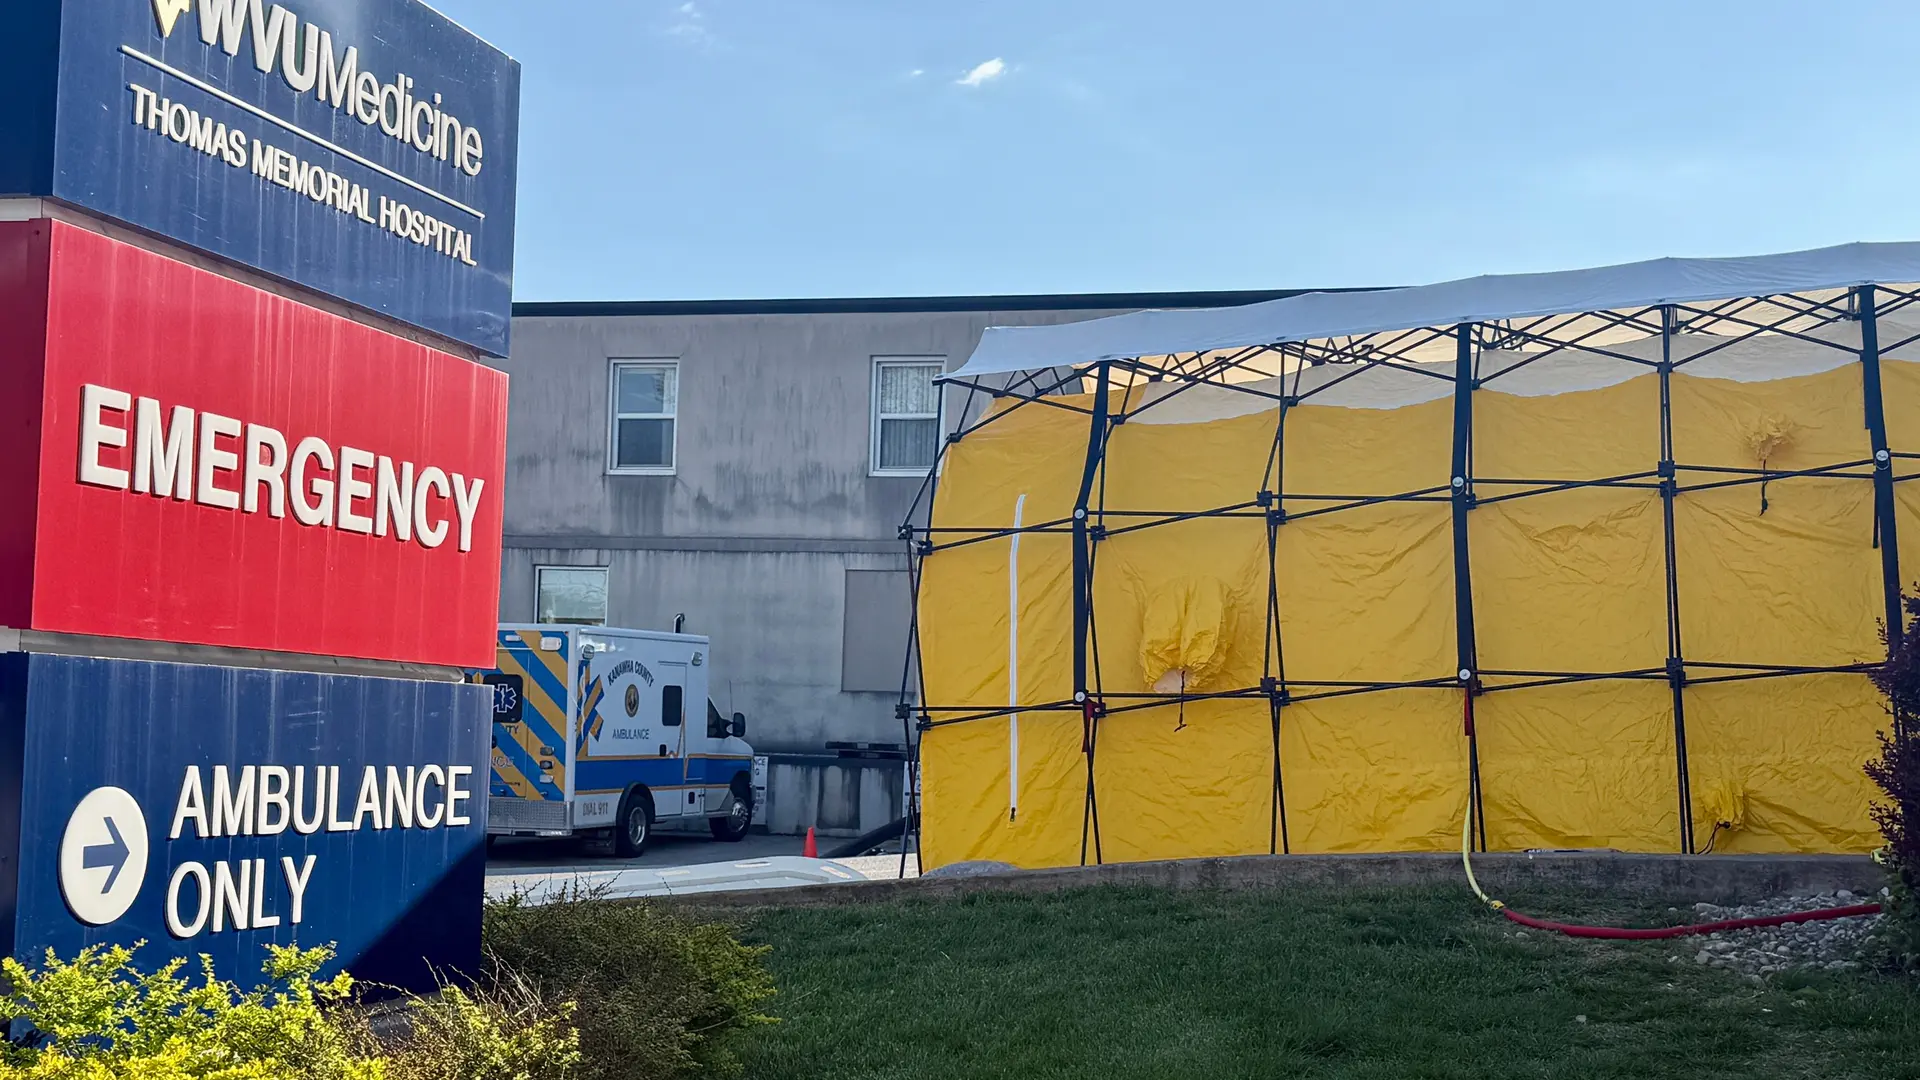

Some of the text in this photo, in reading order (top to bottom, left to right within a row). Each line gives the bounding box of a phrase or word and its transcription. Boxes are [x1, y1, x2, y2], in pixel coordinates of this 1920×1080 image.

[129, 84, 477, 266] THOMAS MEMORIAL HOSPITAL
[79, 383, 485, 553] EMERGENCY
[607, 660, 655, 688] KANAWHA COUNTY
[612, 728, 650, 740] AMBULANCE
[169, 764, 472, 840] AMBULANCE
[165, 854, 317, 938] ONLY
